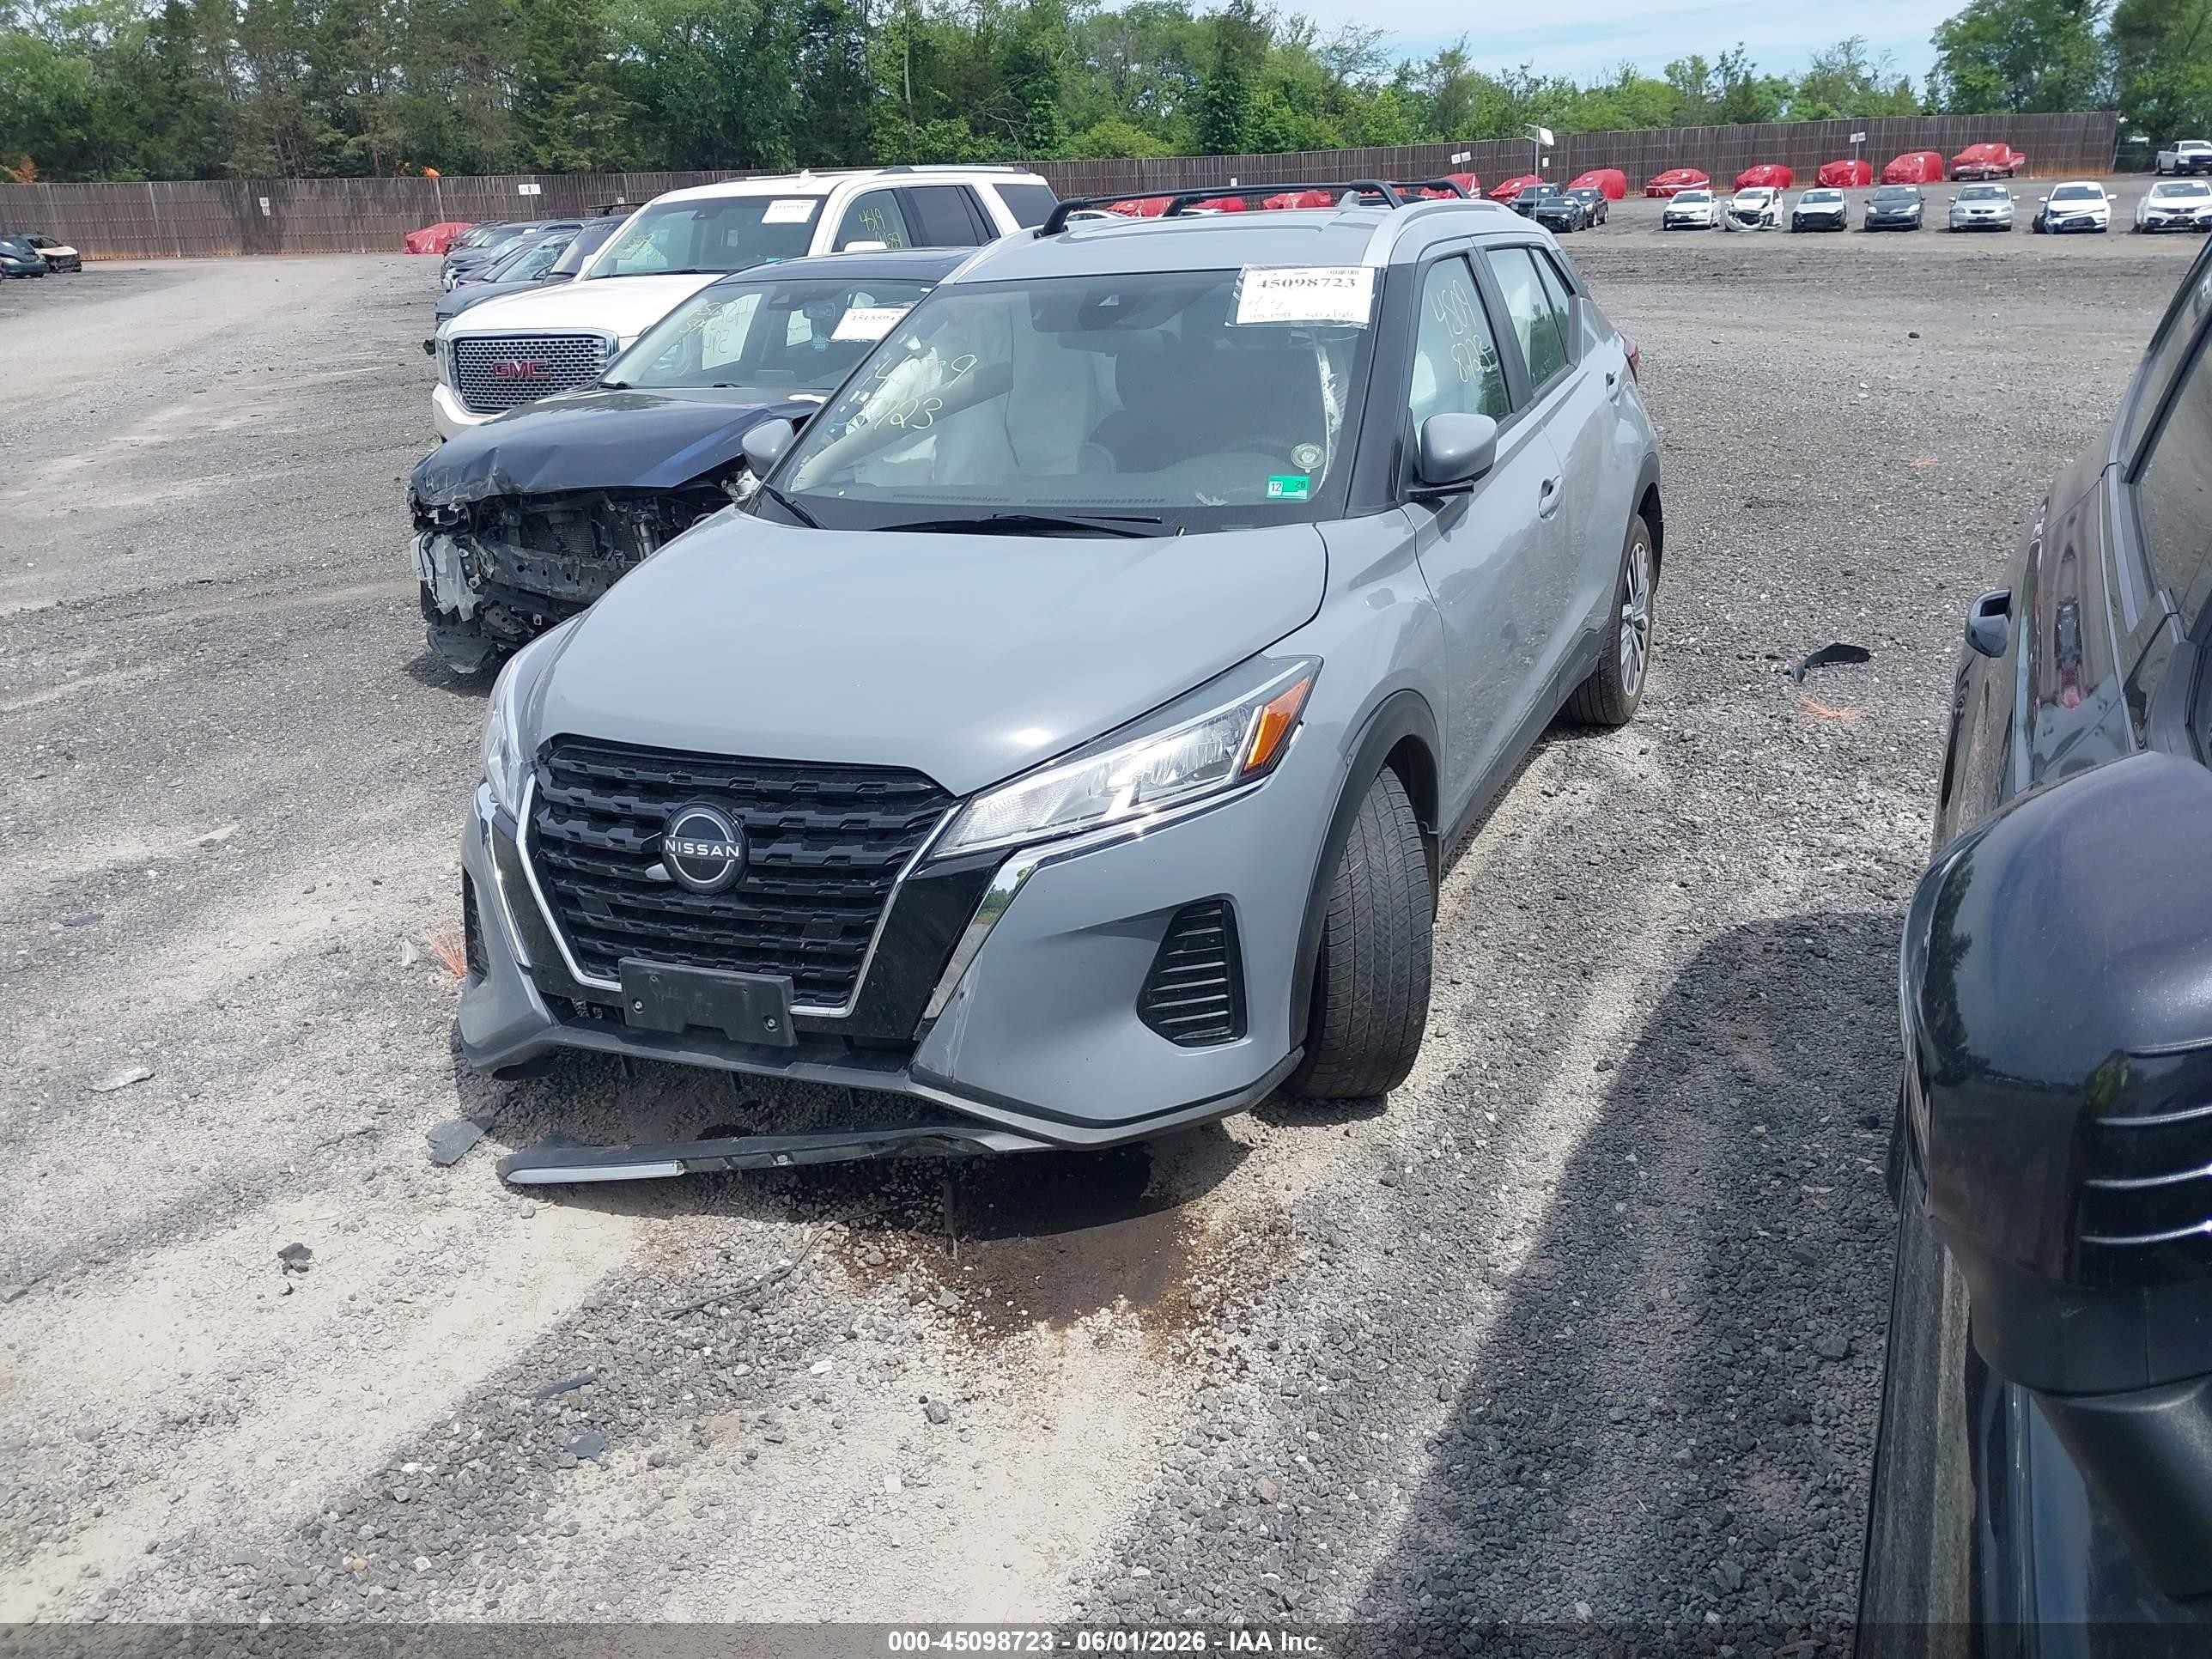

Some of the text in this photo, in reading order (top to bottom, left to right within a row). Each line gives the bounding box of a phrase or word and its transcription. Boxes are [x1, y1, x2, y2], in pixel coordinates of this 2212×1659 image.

[1256, 277, 1357, 289] 45098723
[1428, 280, 1477, 338] 4509
[492, 360, 550, 378] GMC
[1270, 483, 1282, 492] 12
[665, 839, 739, 858] NISSAN
